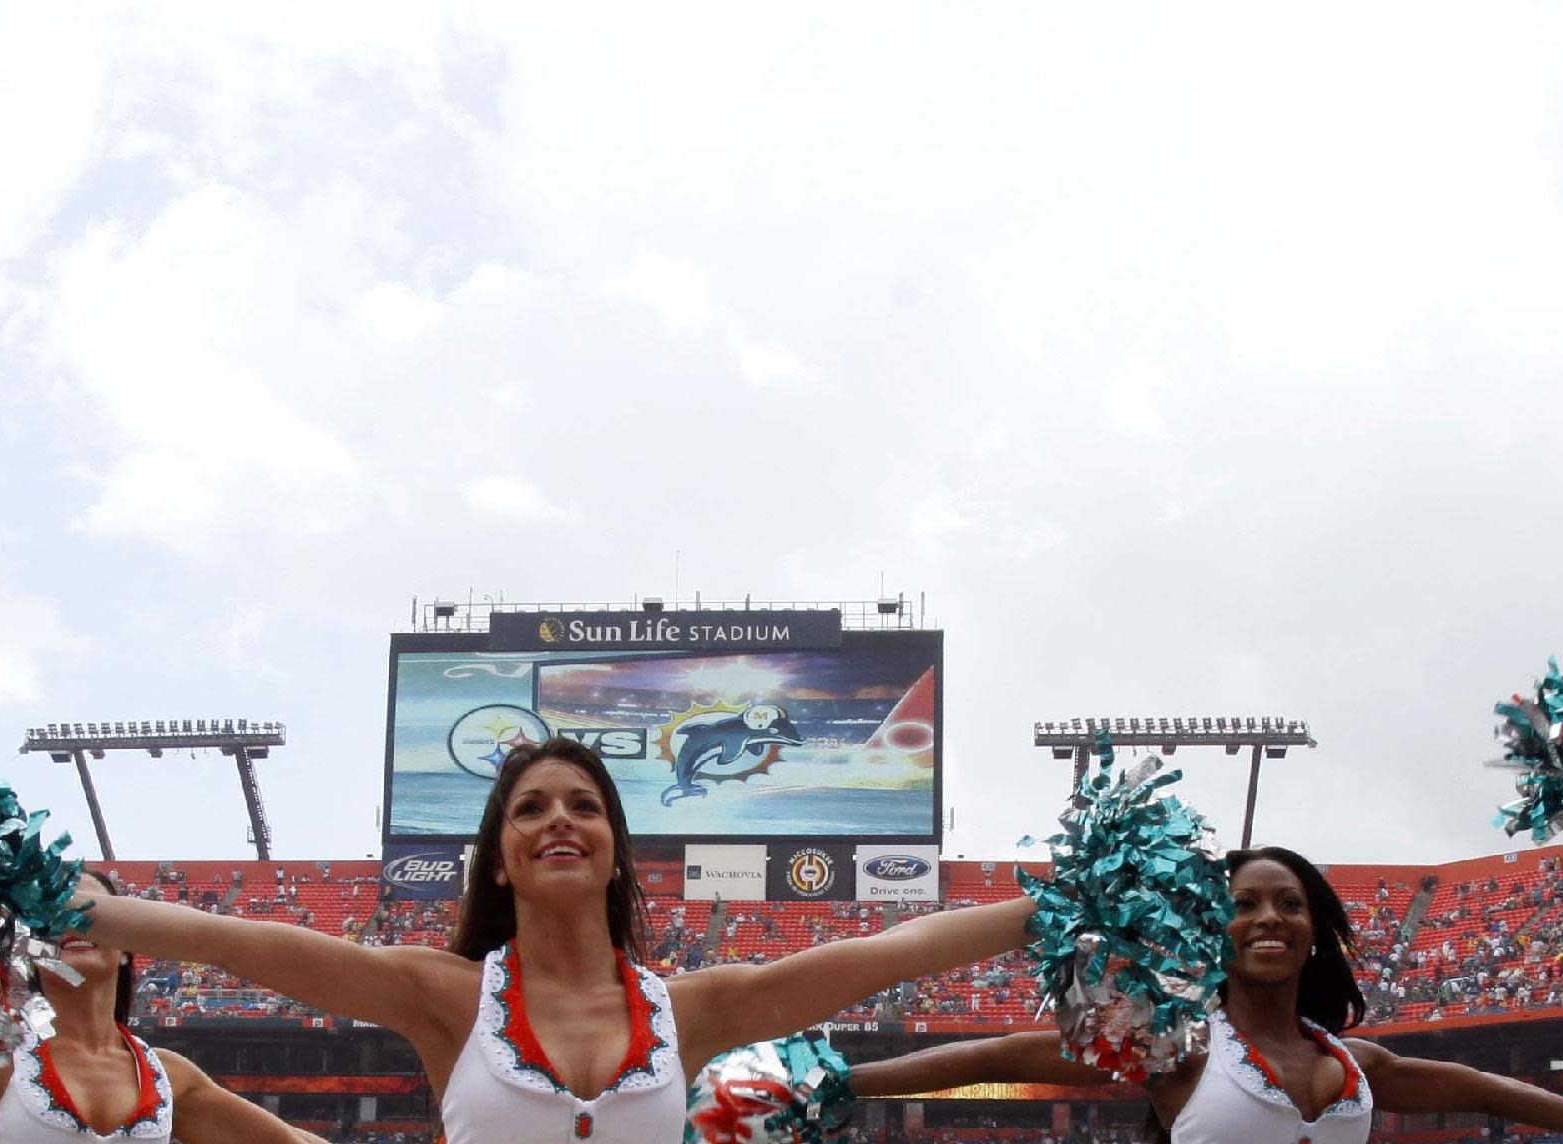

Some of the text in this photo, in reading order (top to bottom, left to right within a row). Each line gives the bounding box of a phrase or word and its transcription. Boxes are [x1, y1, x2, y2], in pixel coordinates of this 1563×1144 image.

[569, 618, 790, 642] Sun Life STADIUM
[560, 731, 642, 756] VS
[403, 860, 434, 871] BUD
[878, 859, 918, 876] Ford
[393, 871, 457, 881] LIGHT
[705, 870, 763, 879] WACHOVIA
[870, 886, 899, 896] Drive
[825, 1021, 859, 1032] DUPER
[864, 1021, 879, 1032] 85
